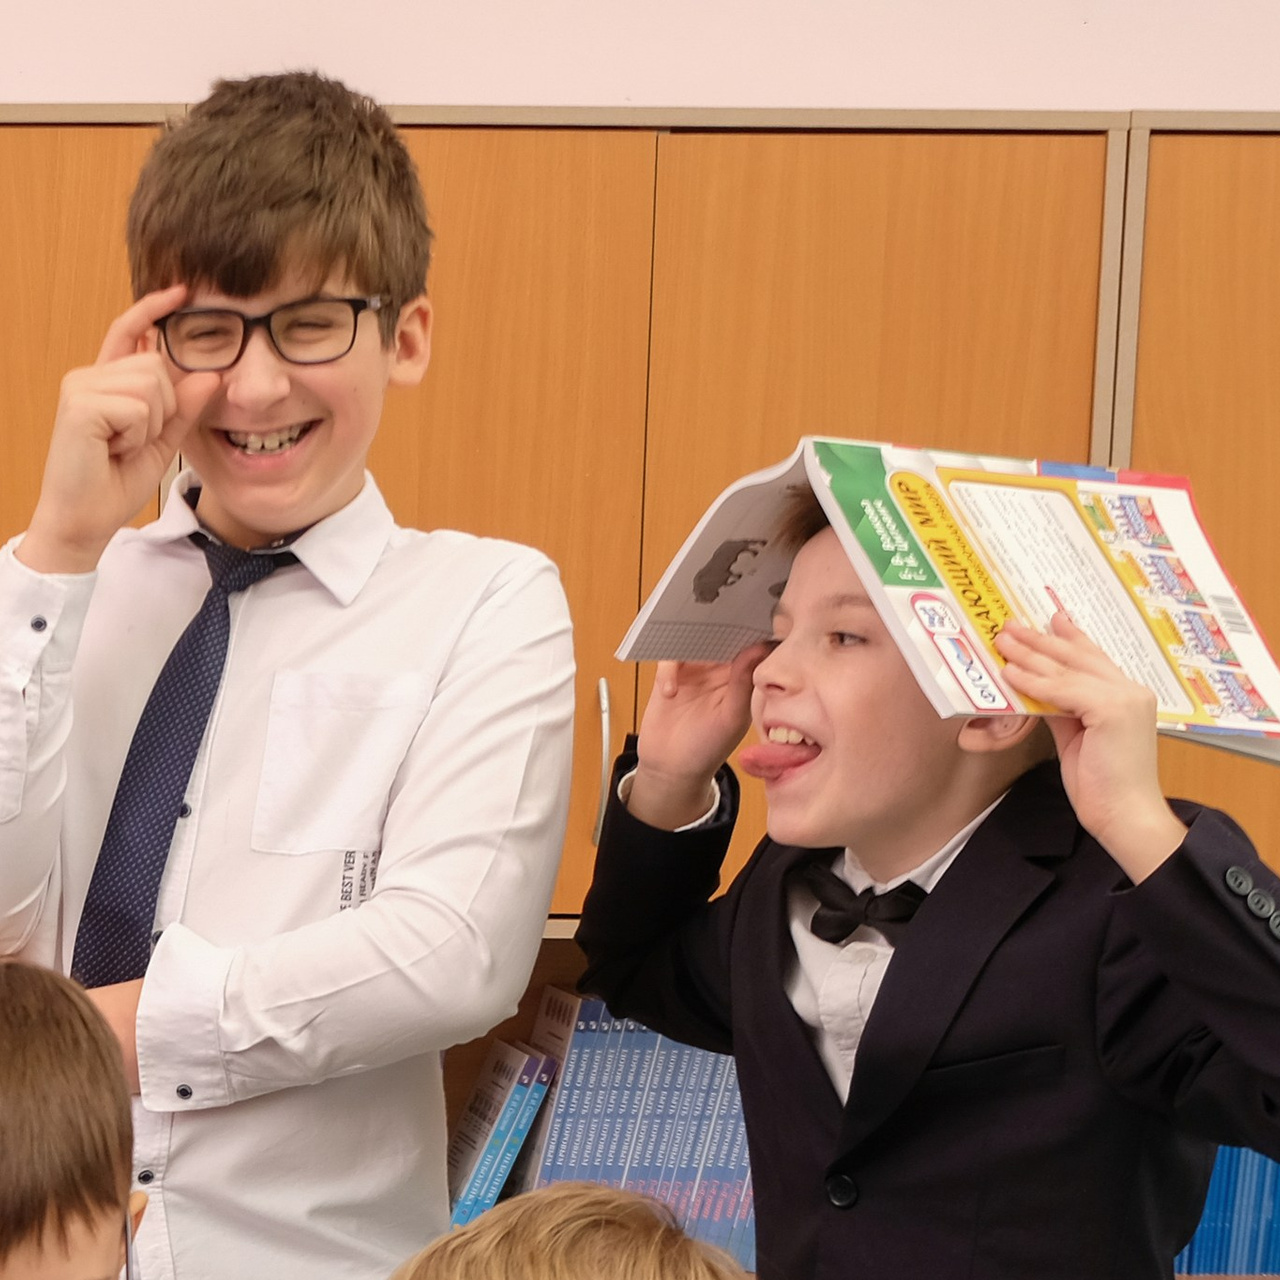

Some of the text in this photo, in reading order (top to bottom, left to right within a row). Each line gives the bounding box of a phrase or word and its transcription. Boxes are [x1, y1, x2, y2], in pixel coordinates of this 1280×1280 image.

[895, 474, 1005, 642] ЖАЮЩИЙ МИР
[341, 874, 354, 901] BEST
[544, 1049, 578, 1166] ЗДОРОВО БЫТЬ ЗДОРОВЫМ
[556, 1048, 590, 1165] ЗДОРОВО БЫТЬ ЗДОРОВЫМ
[568, 1049, 602, 1167] ЗДОРОВО БЫТЬ ЗДОРОВЫМ
[581, 1049, 615, 1166] ЗДОРОВО БЫТЬ ЗДОРОВЫМ
[593, 1048, 627, 1166] ЗДОРОВО БЫТЬ ЗДОРОВЫМ
[605, 1048, 640, 1166] ЗДОРОВО БЫТЬ ЗДОРОВЫМ
[618, 1049, 652, 1166] ЗДОРОВО БЫТЬ ЗДОРОВЫМ
[631, 1050, 665, 1167] ЗДОРОВО БЫТЬ ЗДОРОВЫМ
[643, 1049, 677, 1166] ЗДОРОВО БЫТЬ ЗДОРОВЫМ
[655, 1049, 689, 1167] ЗДОРОВО БЫТЬ ЗДОРОВЫМ
[667, 1051, 702, 1168] ЗДОРОВО БЫТЬ ЗДОРОВЫМ
[679, 1120, 697, 1168] ЗДОРОВЫМ
[691, 1119, 709, 1168] ЗДОРОВЫМ
[693, 1092, 704, 1116] БЫТЬ
[705, 1092, 716, 1116] БЫТЬ
[705, 1119, 722, 1167] ЗДОРОВЫМ
[716, 1119, 733, 1166] ЗДОРОВЫМ
[718, 1091, 729, 1115] БЫТЬ
[463, 1153, 495, 1207] НЕБОЛЕЙКА
[483, 1152, 514, 1206] НЕБОЛЕЙКА
